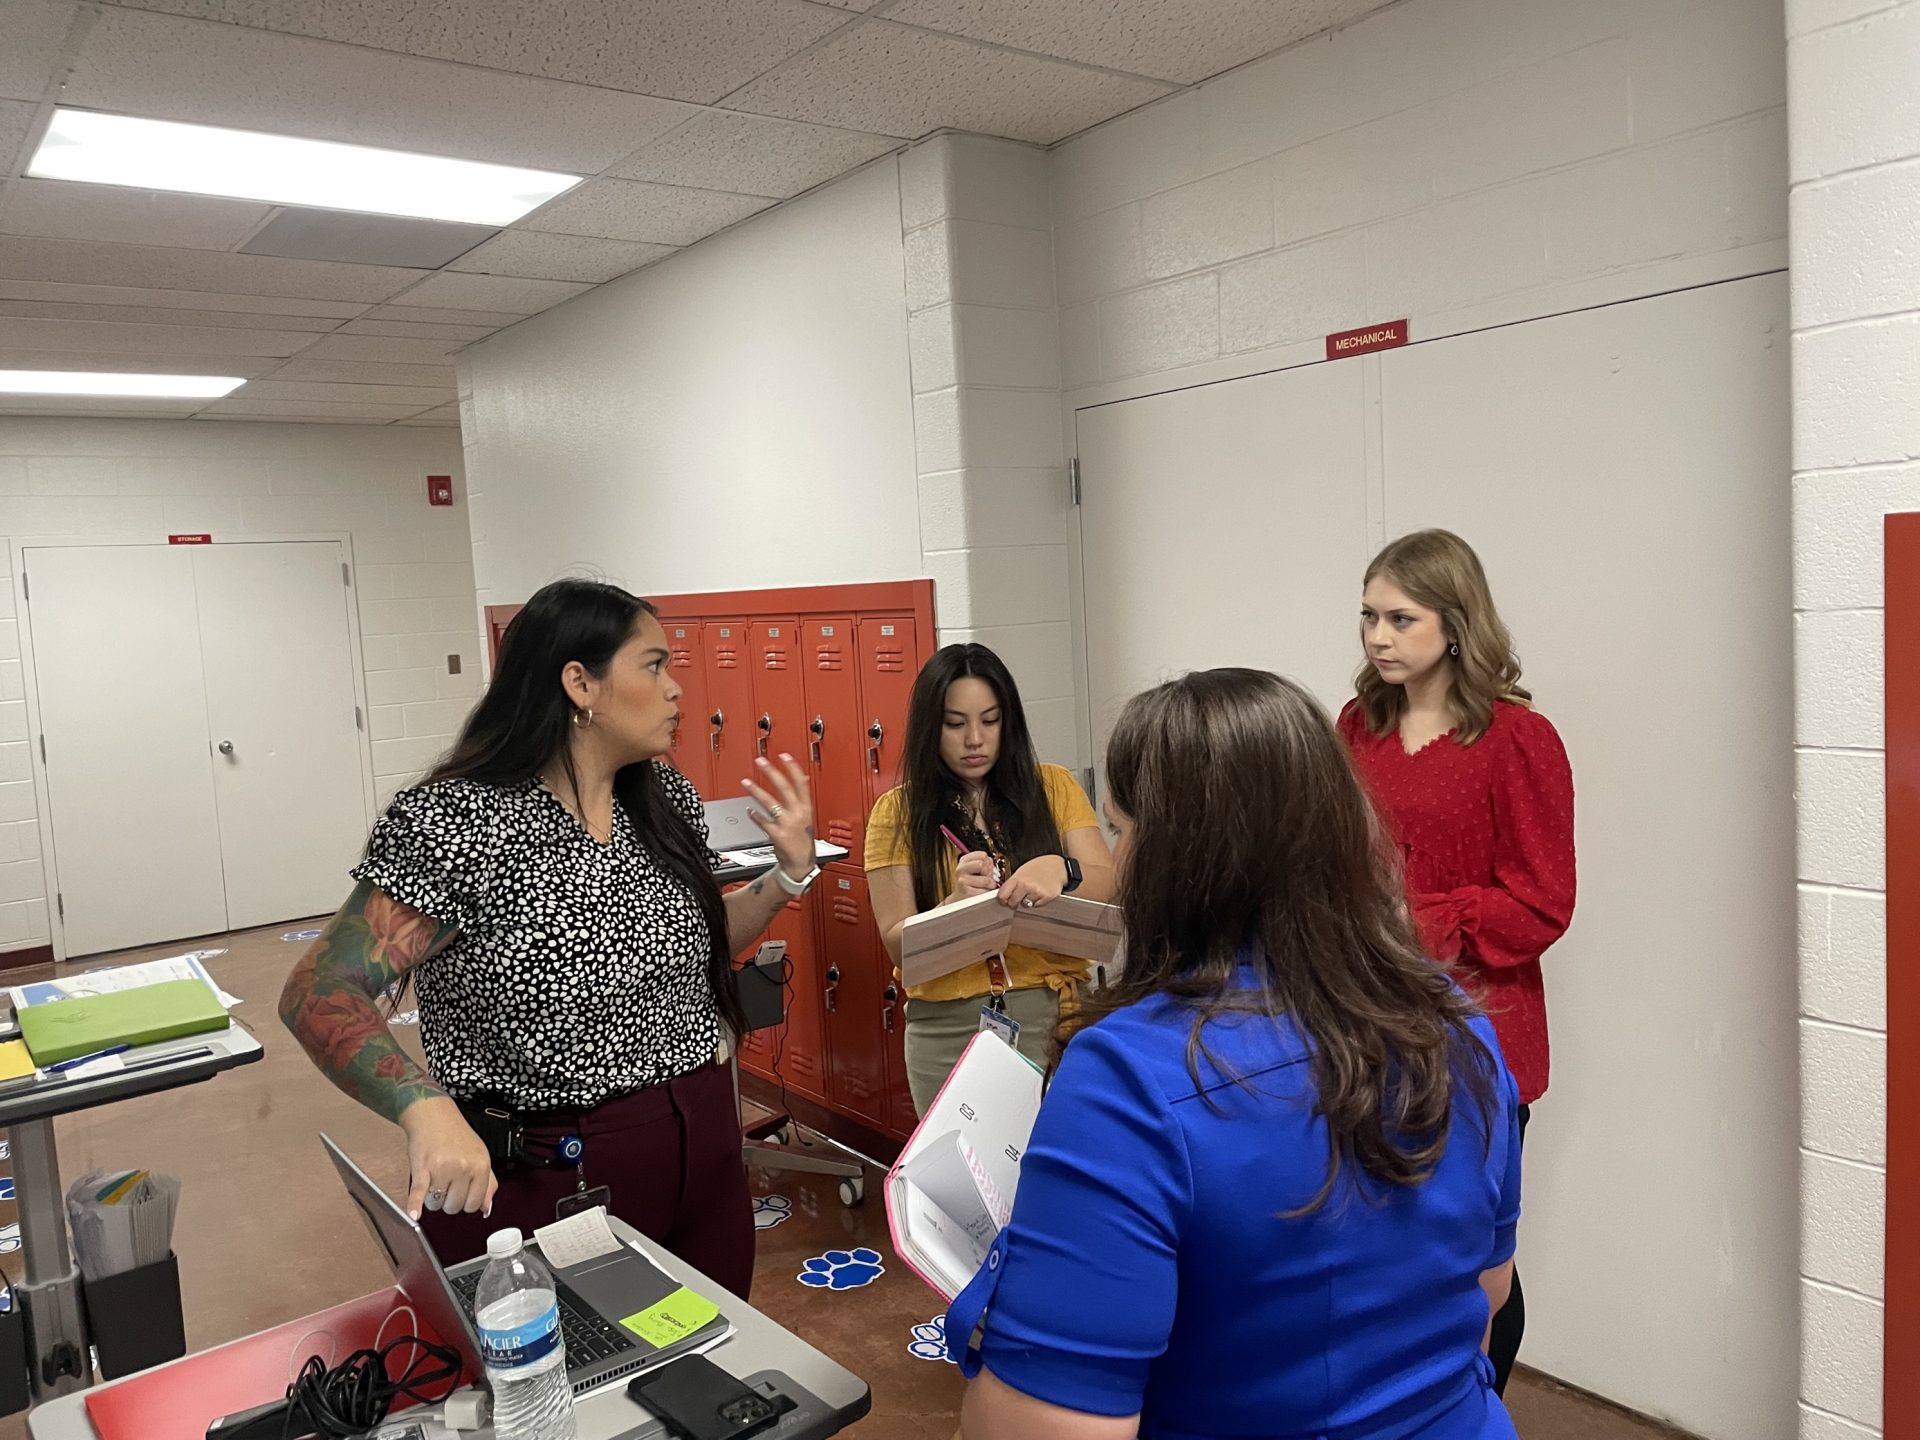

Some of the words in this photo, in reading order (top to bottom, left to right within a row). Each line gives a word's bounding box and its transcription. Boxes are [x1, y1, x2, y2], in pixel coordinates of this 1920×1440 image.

[1336, 329, 1397, 350] MECHANICAL
[959, 1102, 975, 1121] 03
[1004, 1143, 1021, 1162] 04
[480, 1332, 522, 1350] LACIER
